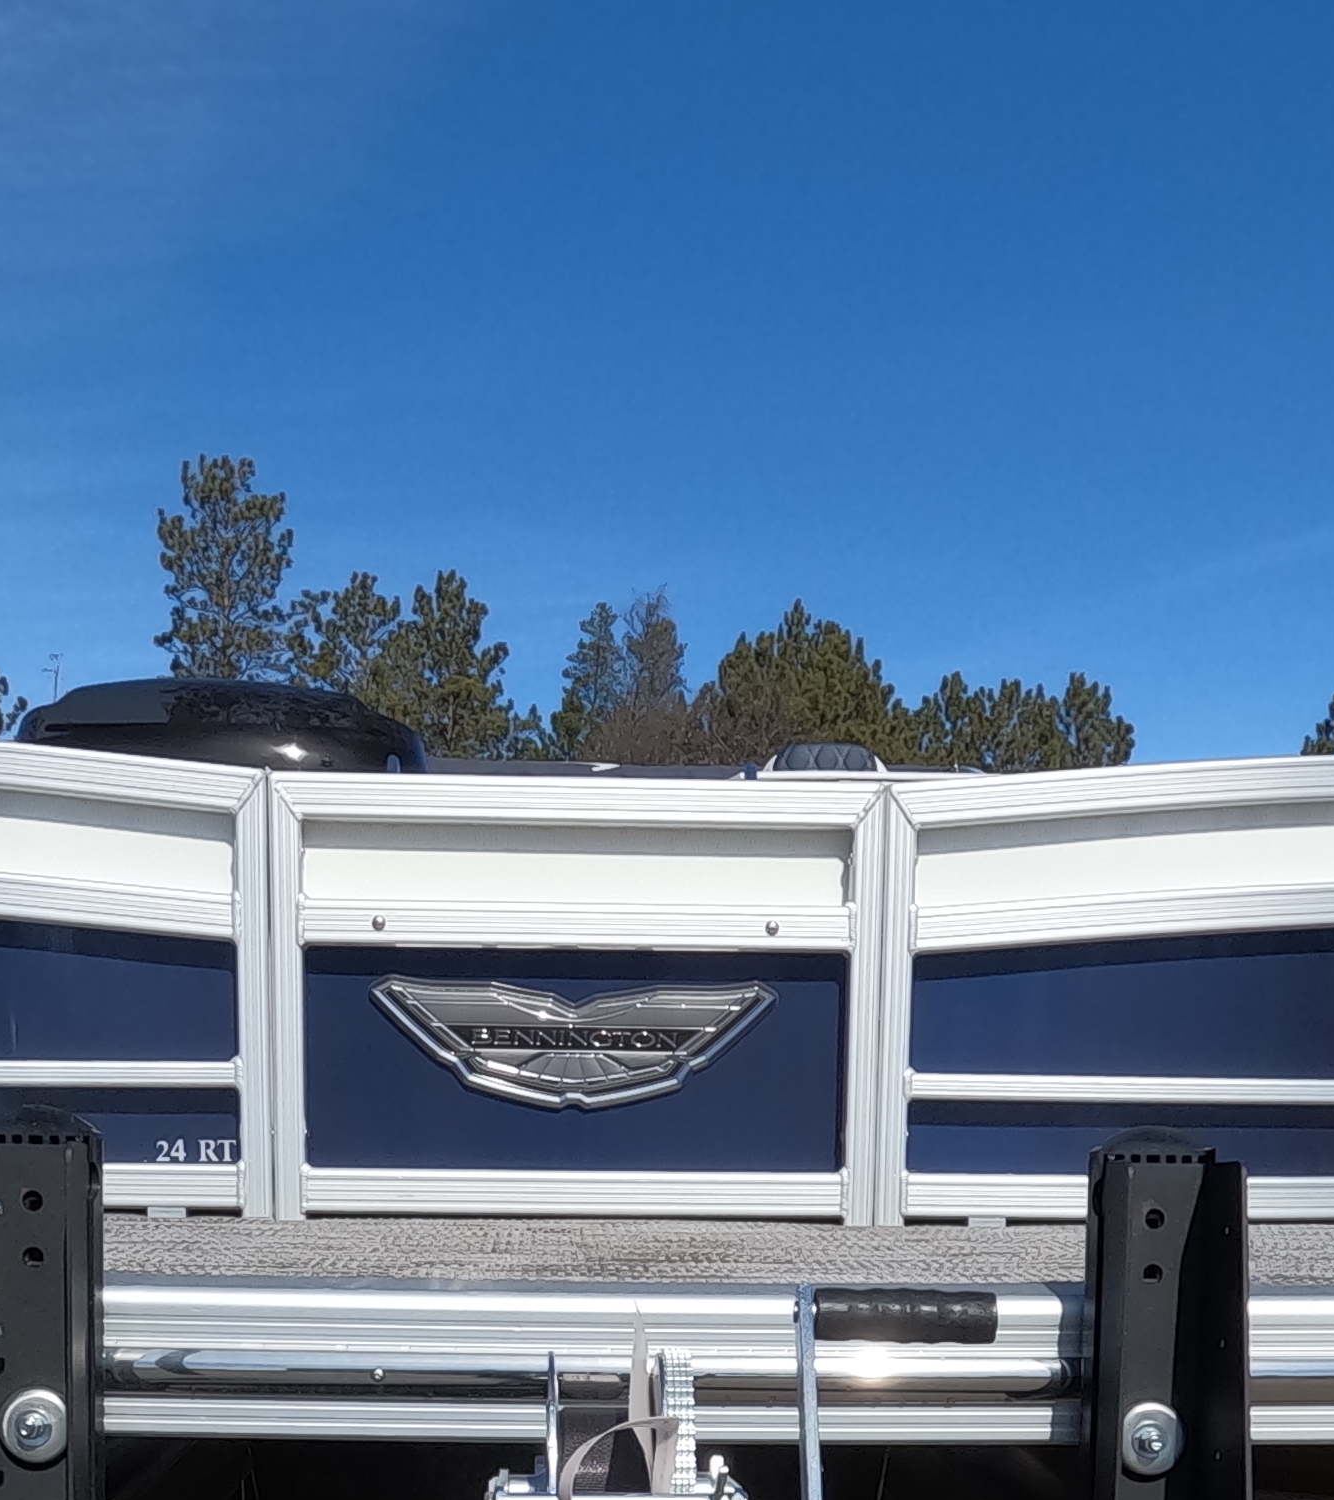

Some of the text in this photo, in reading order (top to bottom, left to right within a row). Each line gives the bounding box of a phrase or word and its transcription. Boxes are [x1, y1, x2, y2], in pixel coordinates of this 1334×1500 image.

[471, 1028, 677, 1048] BENNINGTON
[155, 1138, 237, 1162] 24 RT
